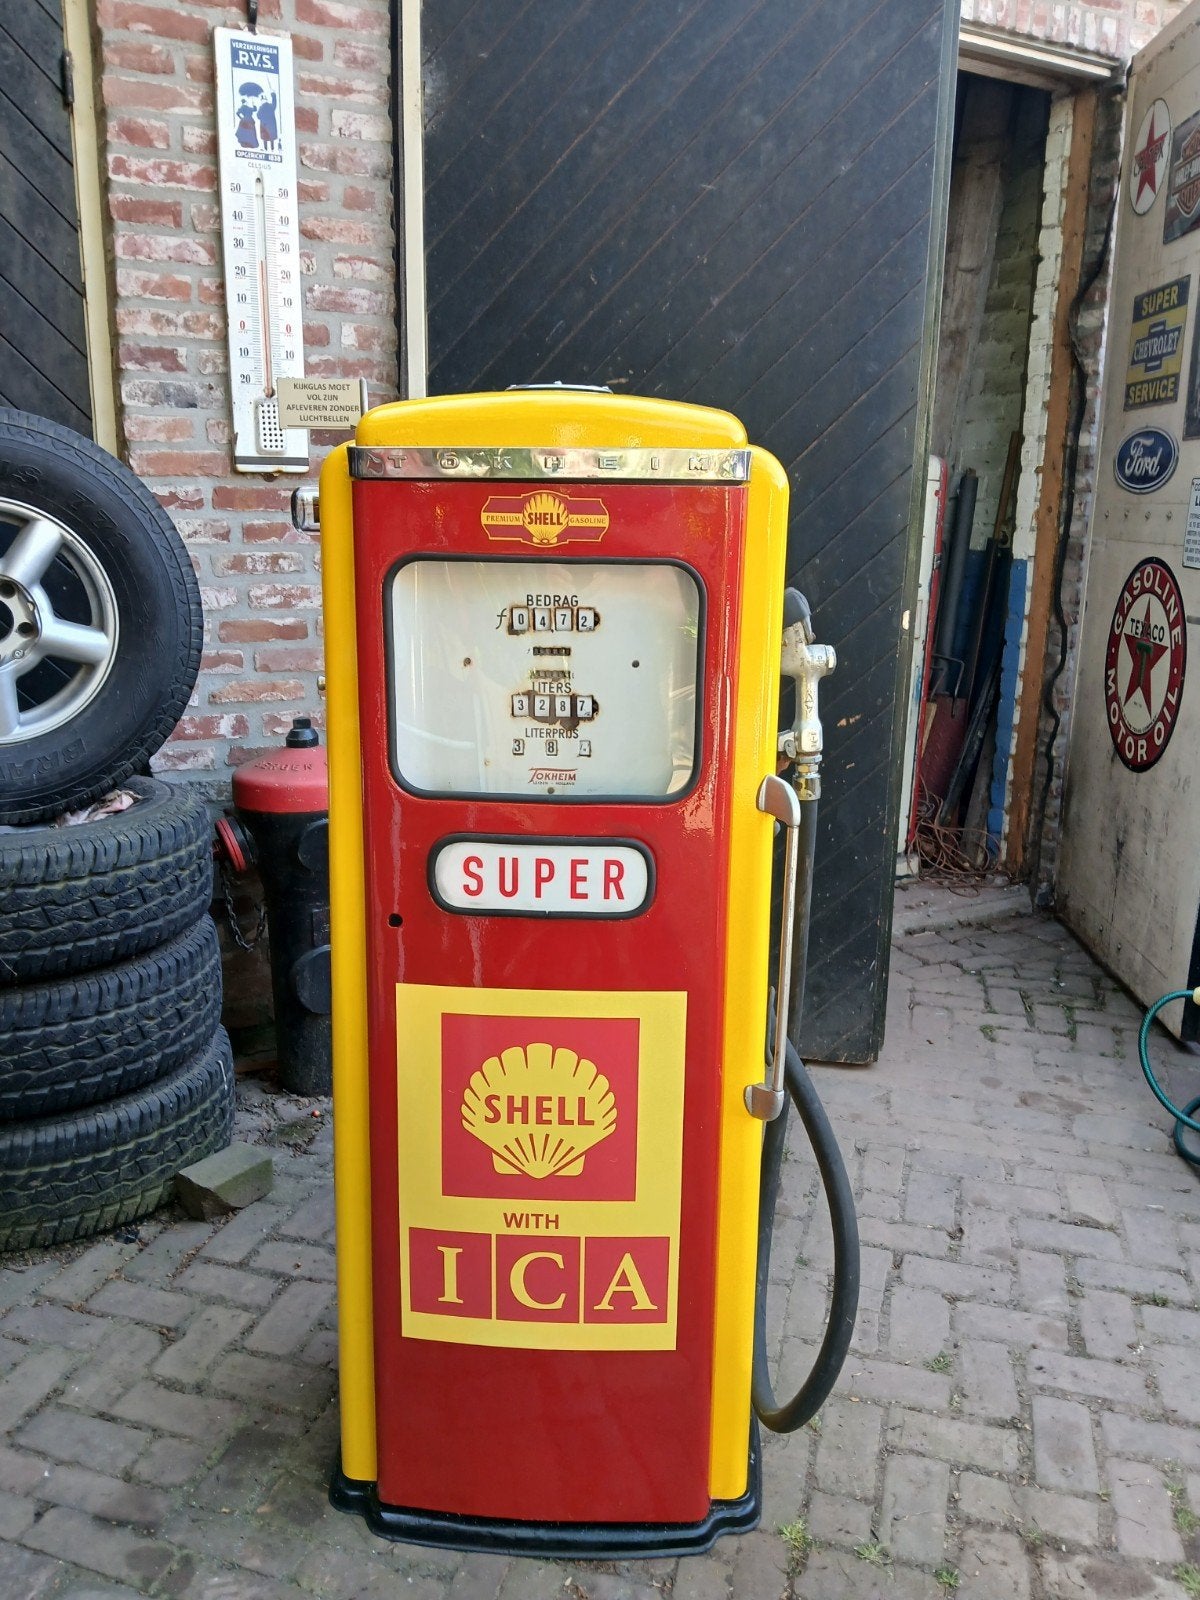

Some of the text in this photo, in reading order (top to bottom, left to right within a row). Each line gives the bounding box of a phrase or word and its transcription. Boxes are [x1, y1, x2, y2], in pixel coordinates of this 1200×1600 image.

[231, 40, 278, 54] VERZEKERINGEN
[248, 162, 271, 170] CELSIUS
[230, 183, 289, 198] 50 50
[232, 211, 290, 225] 40 40
[233, 238, 290, 252] 30 30
[235, 266, 291, 280] 20 20
[236, 293, 292, 307] 10 10
[1141, 285, 1178, 316] SUPER
[239, 320, 292, 333] 0 0
[1133, 330, 1179, 361] CHEVROLET
[239, 348, 295, 360] 10 10
[240, 374, 251, 384] 20
[293, 383, 327, 391] KIJKGLAS
[1128, 380, 1176, 404] SERVICE
[286, 404, 360, 412] AFLEVEREN ZONDER
[299, 414, 350, 422] LUCHTBELLEN
[388, 456, 711, 471] TOKHEIM
[1125, 437, 1160, 478] Ford
[486, 512, 607, 526] PREMIUM SHELL GASOLINE
[526, 594, 579, 607] BEDRAG
[1114, 567, 1182, 650] GASOLINE
[1131, 618, 1165, 643] TEXACO
[532, 682, 572, 694] LITERS
[1107, 668, 1147, 763] MOTOR
[1154, 687, 1178, 746] OIL
[528, 767, 578, 783] TOKHEIM
[462, 855, 625, 900] SUPER
[485, 1094, 595, 1127] SHELL
[503, 1212, 560, 1230] WITH
